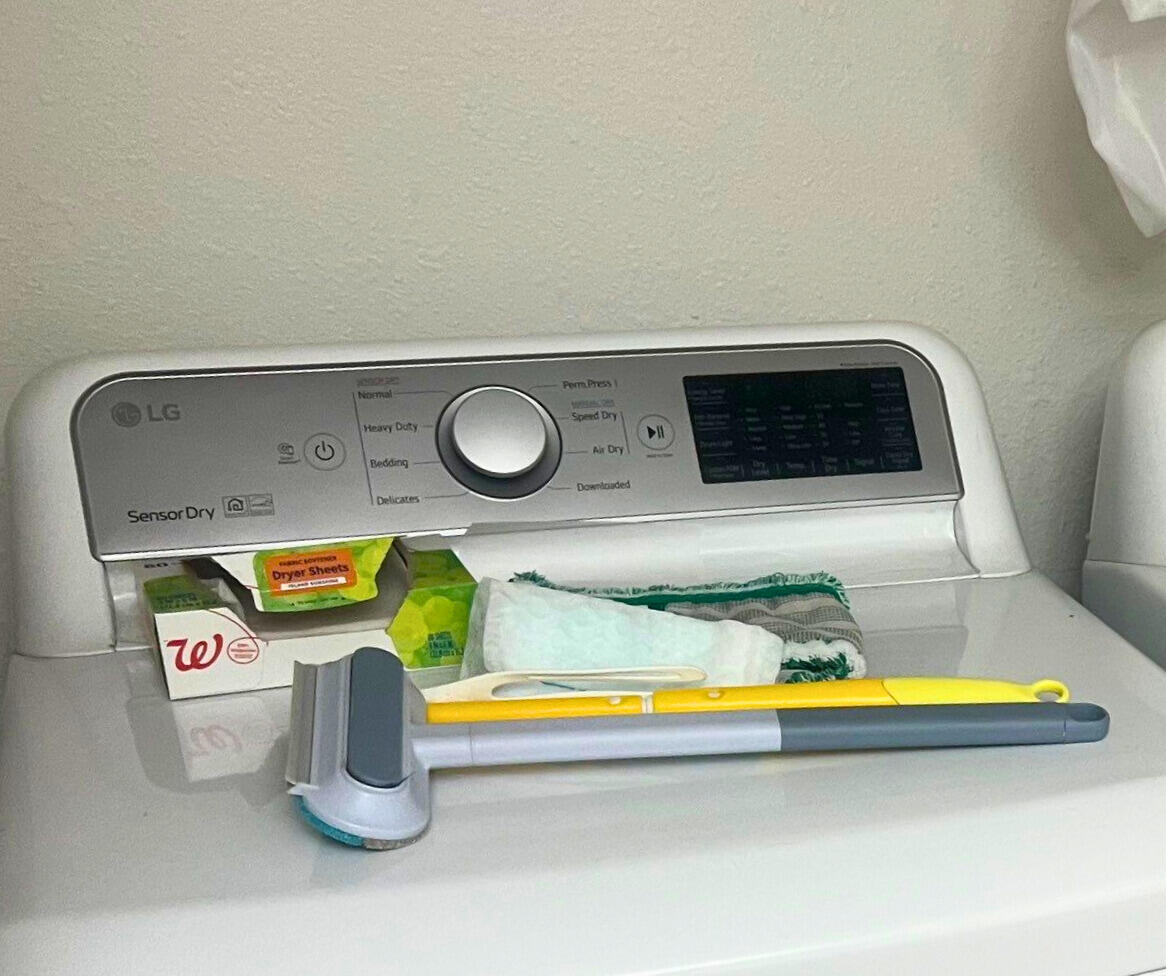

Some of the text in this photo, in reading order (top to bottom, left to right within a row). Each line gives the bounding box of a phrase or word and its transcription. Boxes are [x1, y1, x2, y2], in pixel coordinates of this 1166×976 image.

[358, 390, 392, 400] Normal
[147, 404, 180, 422] LG
[572, 410, 617, 422] Speed Dry
[364, 422, 418, 433] Heavy Duty
[593, 444, 624, 455] Air Dry
[371, 459, 408, 469] Bedding
[577, 480, 631, 492] Downloaded
[377, 495, 420, 506] Delicates
[272, 563, 349, 582] Dryer Sheets
